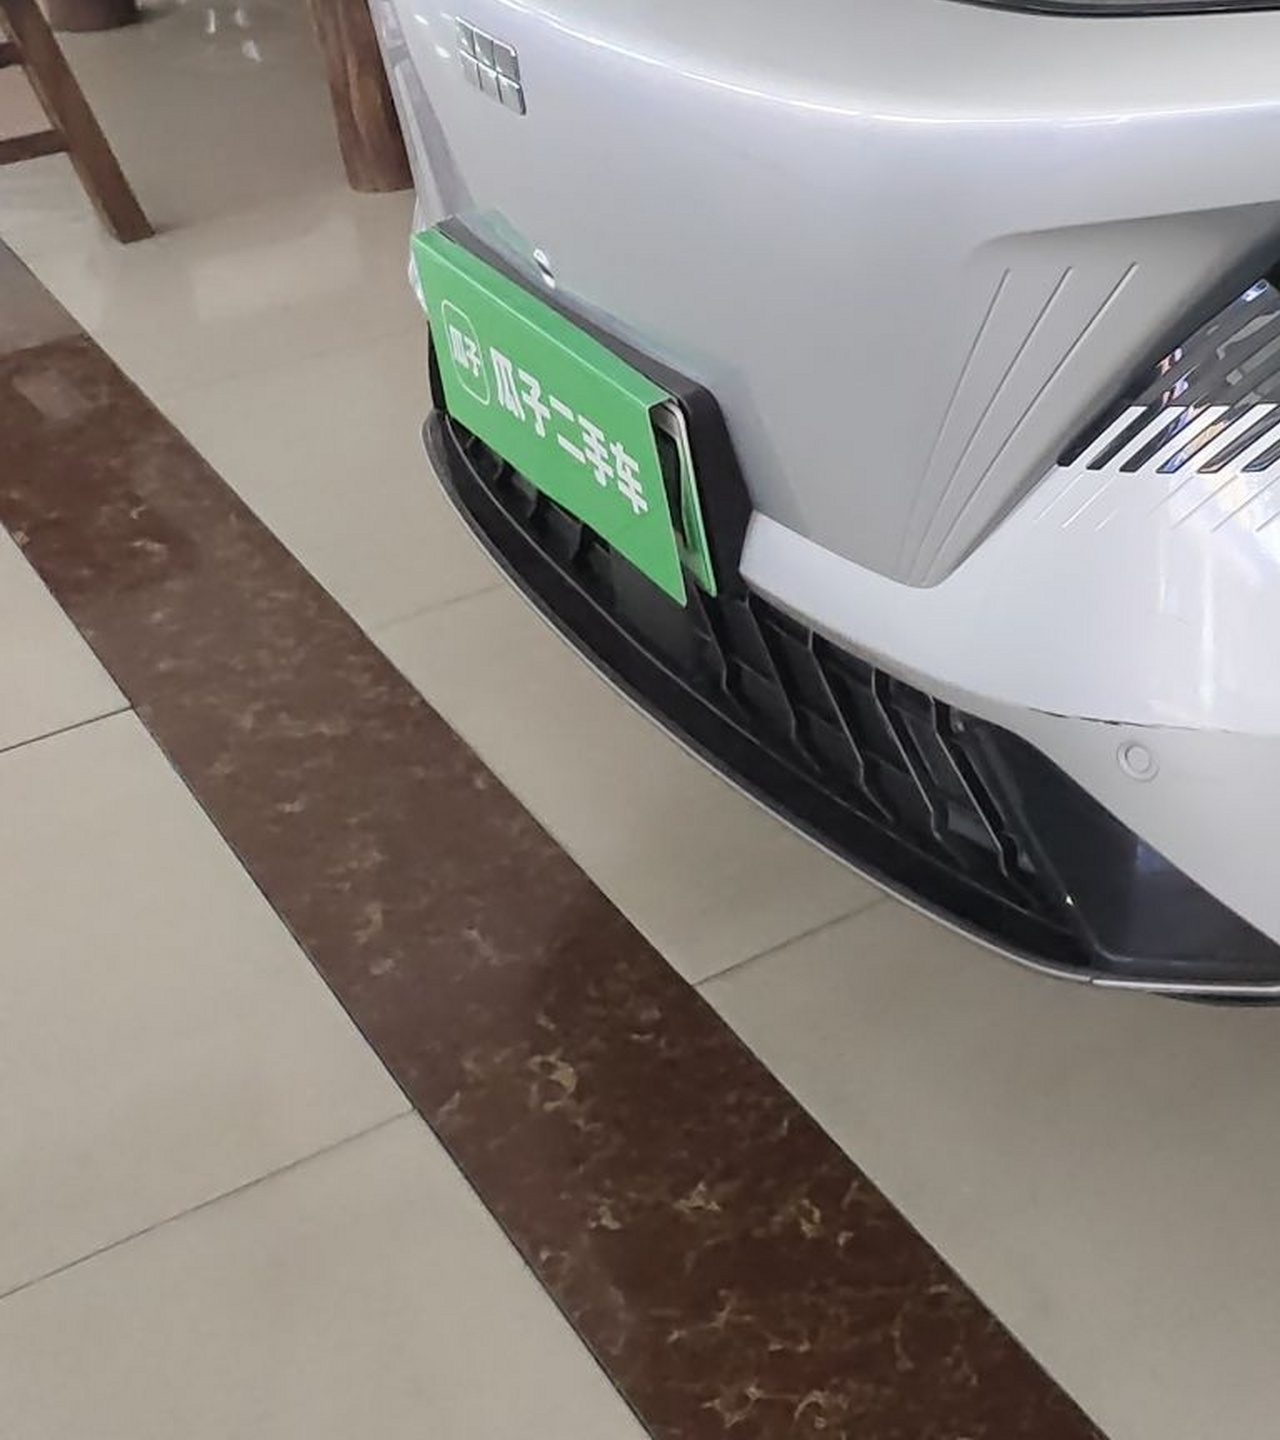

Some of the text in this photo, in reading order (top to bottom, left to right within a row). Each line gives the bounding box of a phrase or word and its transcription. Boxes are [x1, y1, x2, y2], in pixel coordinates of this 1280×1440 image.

[489, 346, 648, 515] 瓜子二手车
